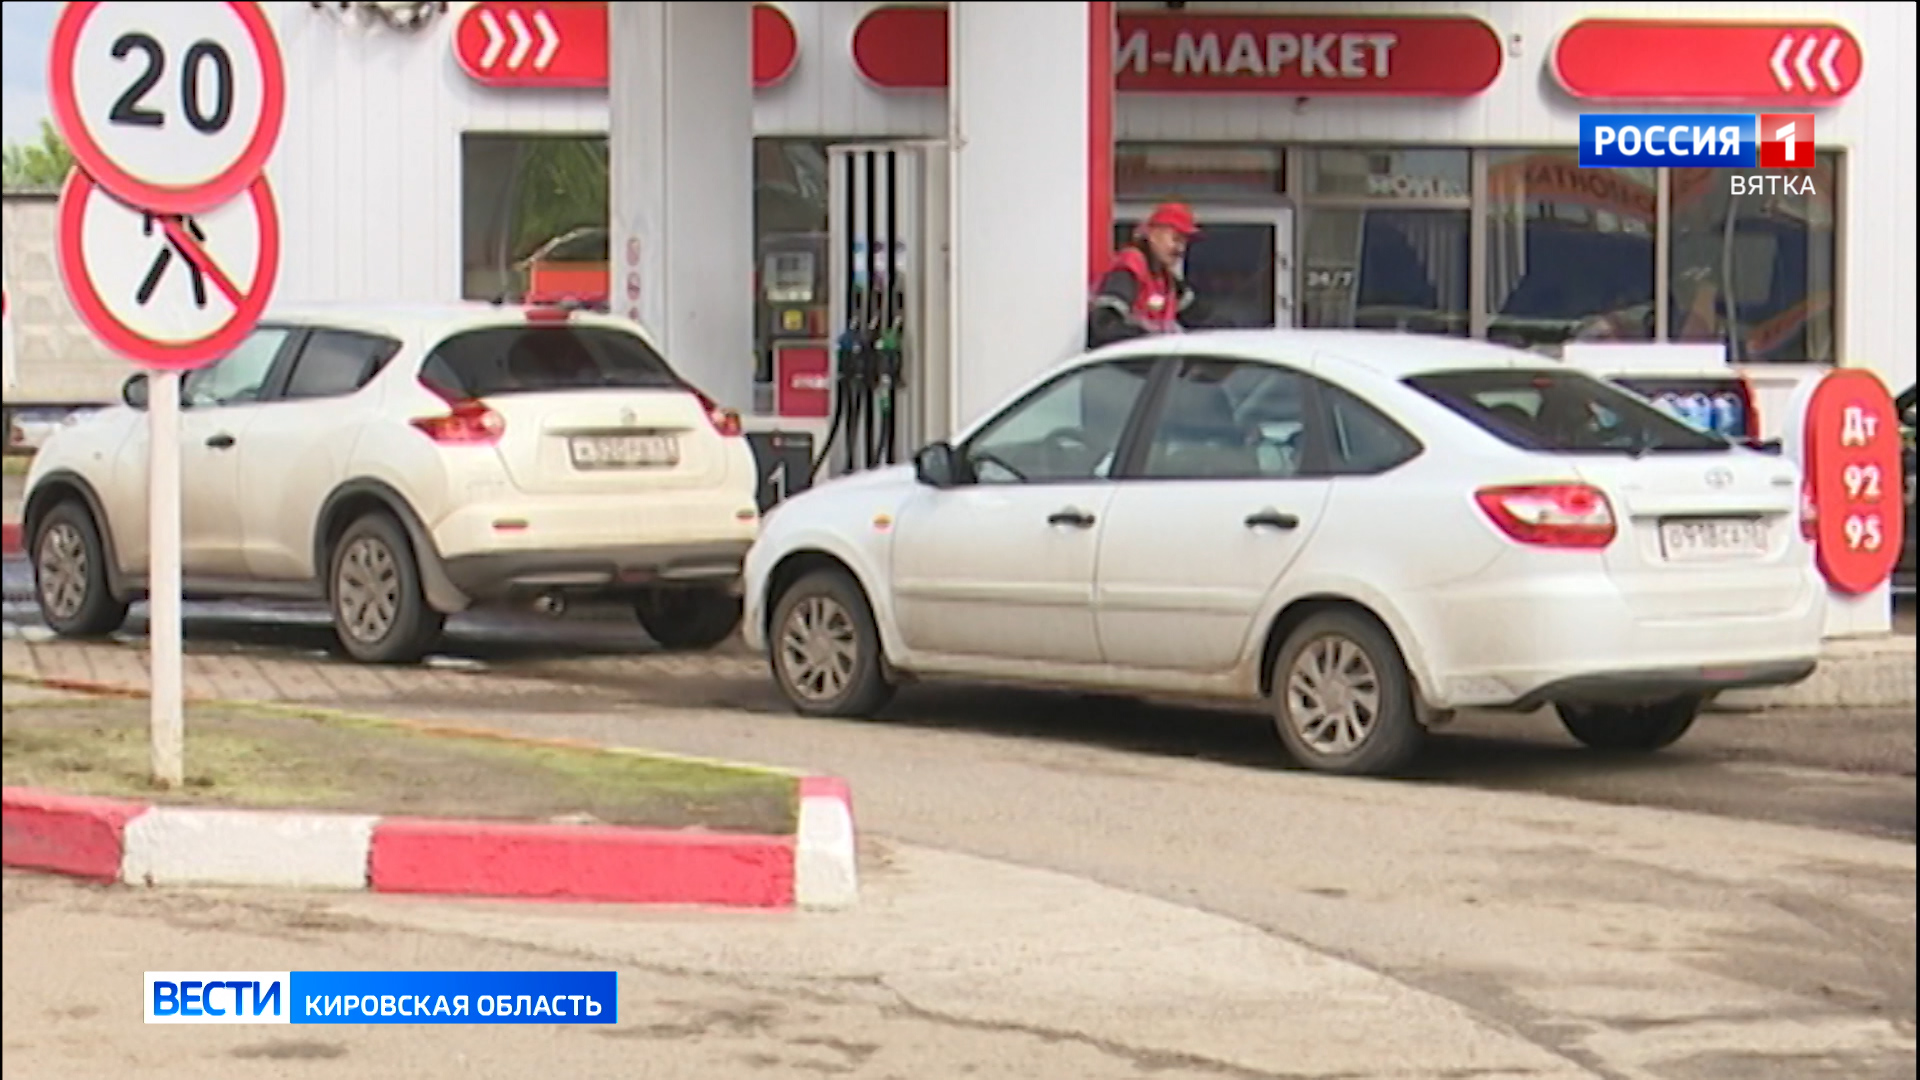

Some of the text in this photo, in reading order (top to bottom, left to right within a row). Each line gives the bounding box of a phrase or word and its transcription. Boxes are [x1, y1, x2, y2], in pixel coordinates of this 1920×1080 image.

[108, 31, 234, 136] 20
[1840, 405, 1878, 447] Дт
[1842, 464, 1882, 500] 92
[1843, 514, 1882, 552] 95
